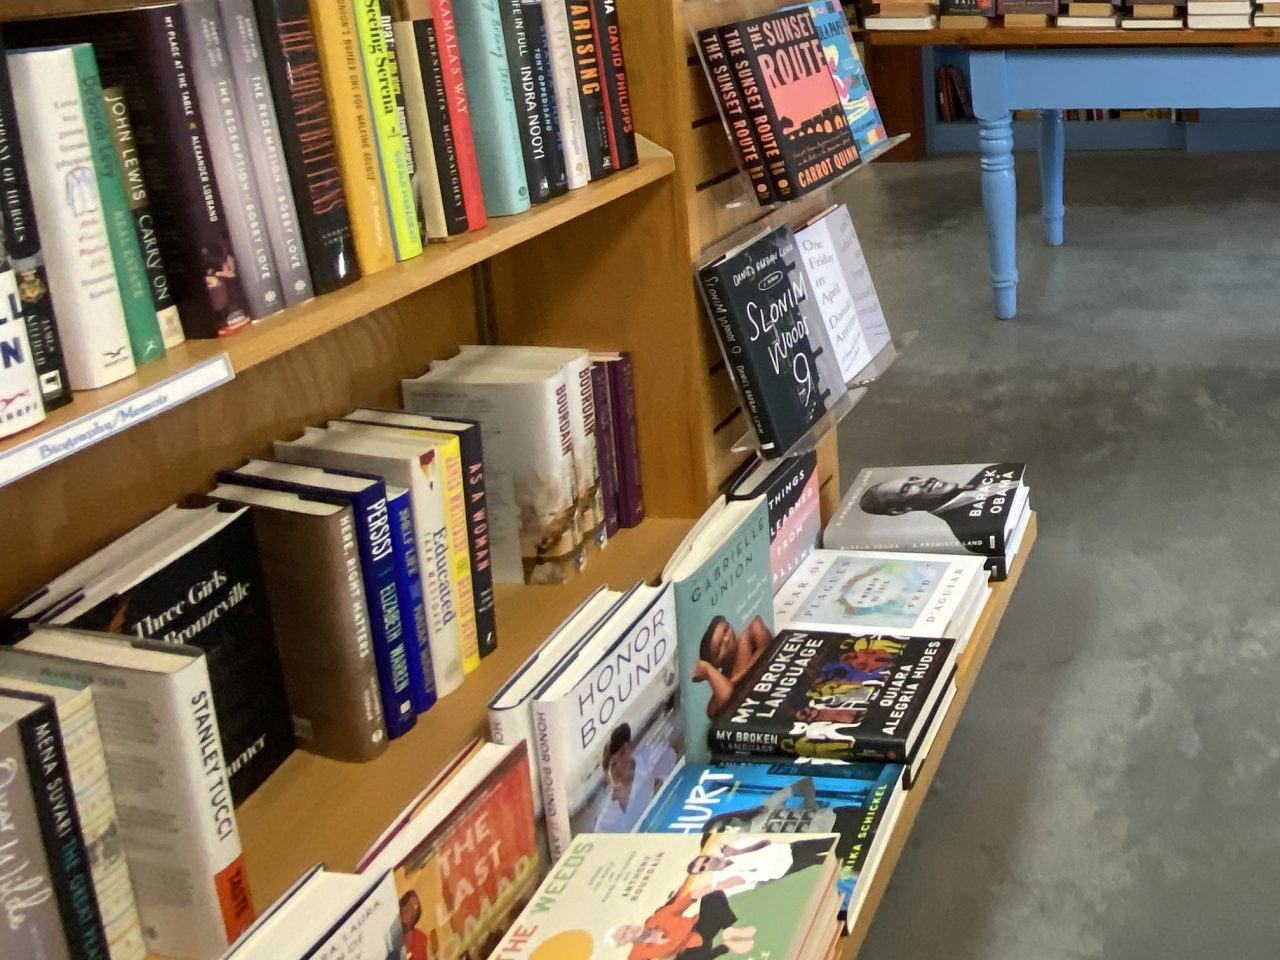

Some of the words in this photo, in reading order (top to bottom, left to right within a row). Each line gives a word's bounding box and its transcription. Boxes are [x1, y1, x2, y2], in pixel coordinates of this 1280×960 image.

[517, 31, 527, 57] FULL
[570, 4, 600, 95] ARISING
[608, 25, 623, 67] DAVID
[747, 24, 764, 50] THE
[762, 13, 815, 46] SUNSET
[374, 56, 394, 114] Serena
[520, 66, 536, 111] INDRA
[725, 30, 744, 56] THE
[736, 61, 764, 110] SUNSET
[754, 114, 780, 157] ROUTE
[757, 40, 824, 88] ROUTE
[454, 82, 468, 114] WAY
[613, 71, 632, 133] PHILIPPS
[703, 35, 723, 61] THE
[714, 66, 741, 115] SUNSET
[734, 122, 758, 161] ROUTE
[106, 94, 129, 141] JOHN
[122, 145, 146, 201] LEWIS
[528, 114, 545, 160] NOOYI
[798, 161, 833, 188] CARROT
[834, 145, 858, 170] QUINN
[223, 108, 250, 190] REDEMPTION
[256, 247, 271, 280] LOVE
[258, 103, 280, 183] REDEMPTION
[286, 240, 300, 270] LOVE
[139, 214, 162, 269] CARRY
[747, 272, 807, 341] SLONIM
[768, 316, 808, 375] WOODS
[556, 384, 572, 456] BOURDAIN
[578, 367, 594, 438] BOURDAIN
[767, 469, 806, 511] THINGS
[770, 488, 814, 536] LEARNED
[969, 469, 998, 517] BARACK
[989, 470, 1014, 514] OBAMA
[367, 499, 392, 562] PERSIST
[473, 514, 490, 572] WOMAN
[691, 516, 766, 603] GABRIELLE
[432, 526, 456, 626] Educated
[578, 609, 665, 717] HONOR
[753, 633, 809, 693] BROKEN
[757, 639, 824, 720] LANGUAGE
[879, 664, 914, 708] QUIARA
[882, 680, 919, 736] ALEGRIA
[915, 641, 941, 681] HUDES
[580, 638, 668, 750] BOUND
[35, 722, 59, 775] MENA
[190, 690, 222, 775] STANLEY
[207, 775, 234, 842] TUCCI
[667, 769, 734, 833] HURT
[857, 784, 887, 839] SCHICKEL
[531, 842, 594, 913] WEEDS
